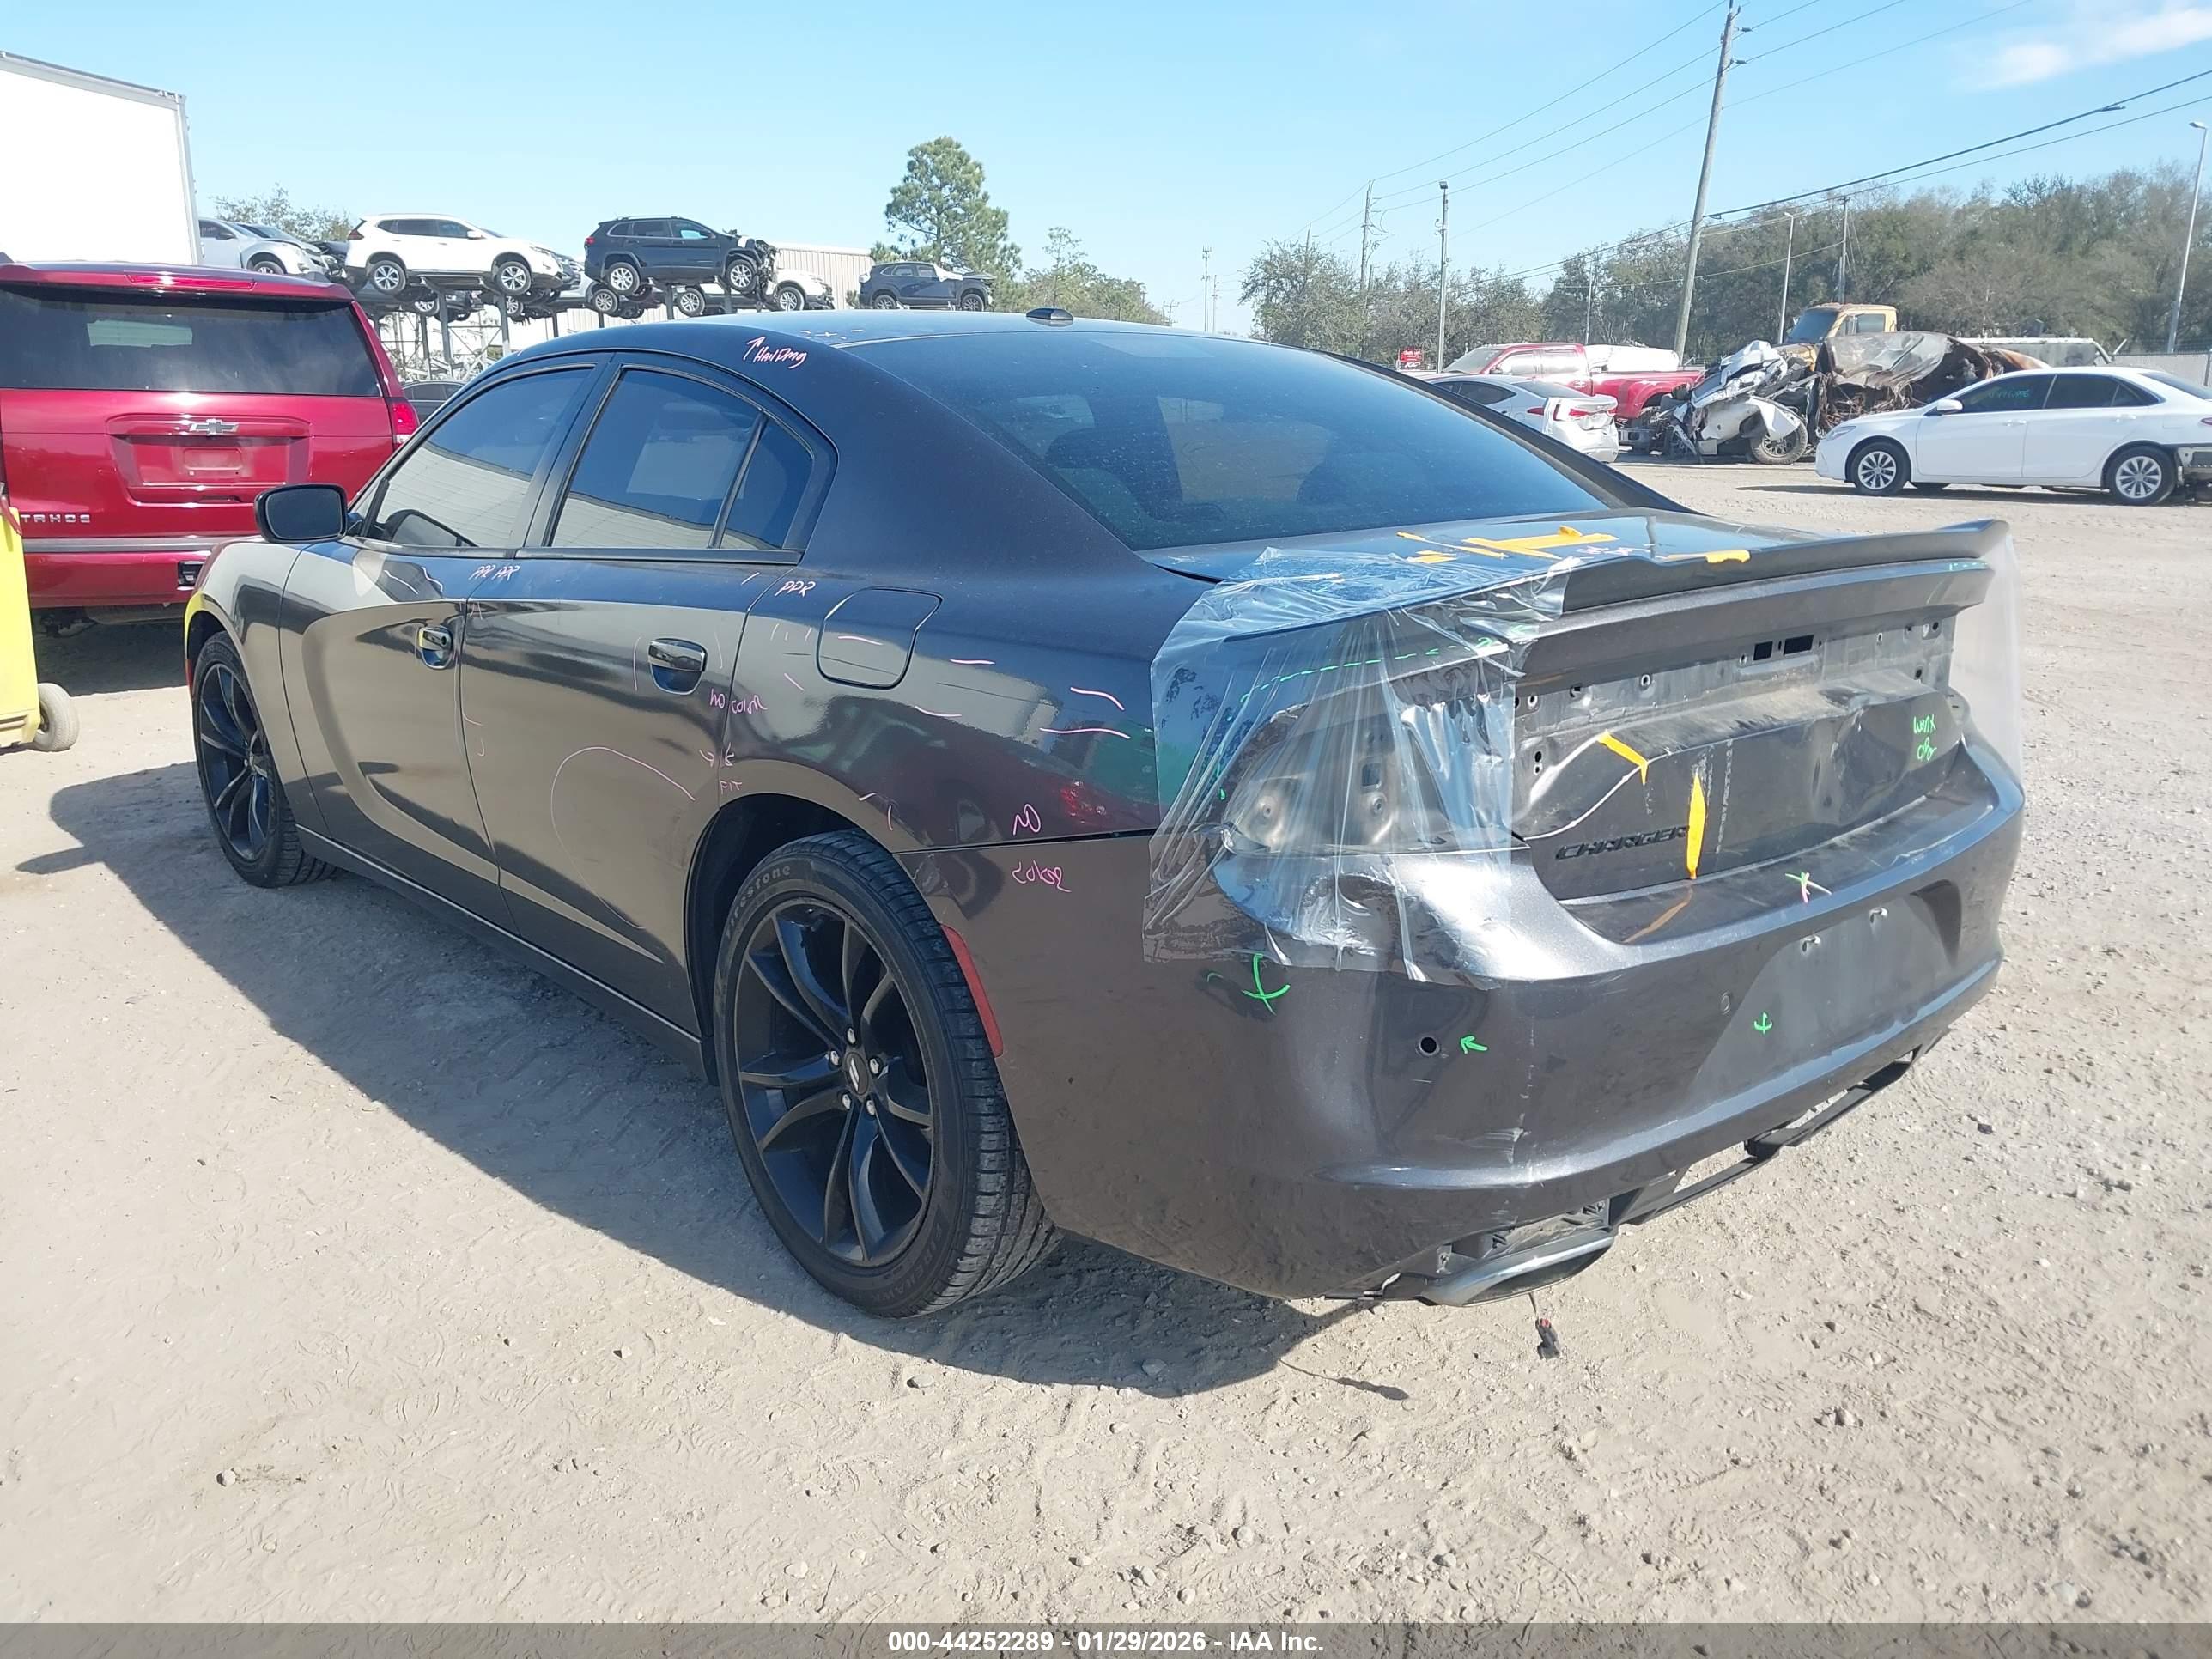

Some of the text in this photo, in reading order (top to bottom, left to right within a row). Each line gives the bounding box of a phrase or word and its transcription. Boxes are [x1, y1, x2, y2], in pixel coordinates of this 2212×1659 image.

[20, 514, 90, 523] TAHOE
[774, 580, 817, 598] PPR
[720, 780, 743, 793] FIT
[1012, 803, 1042, 836] NO
